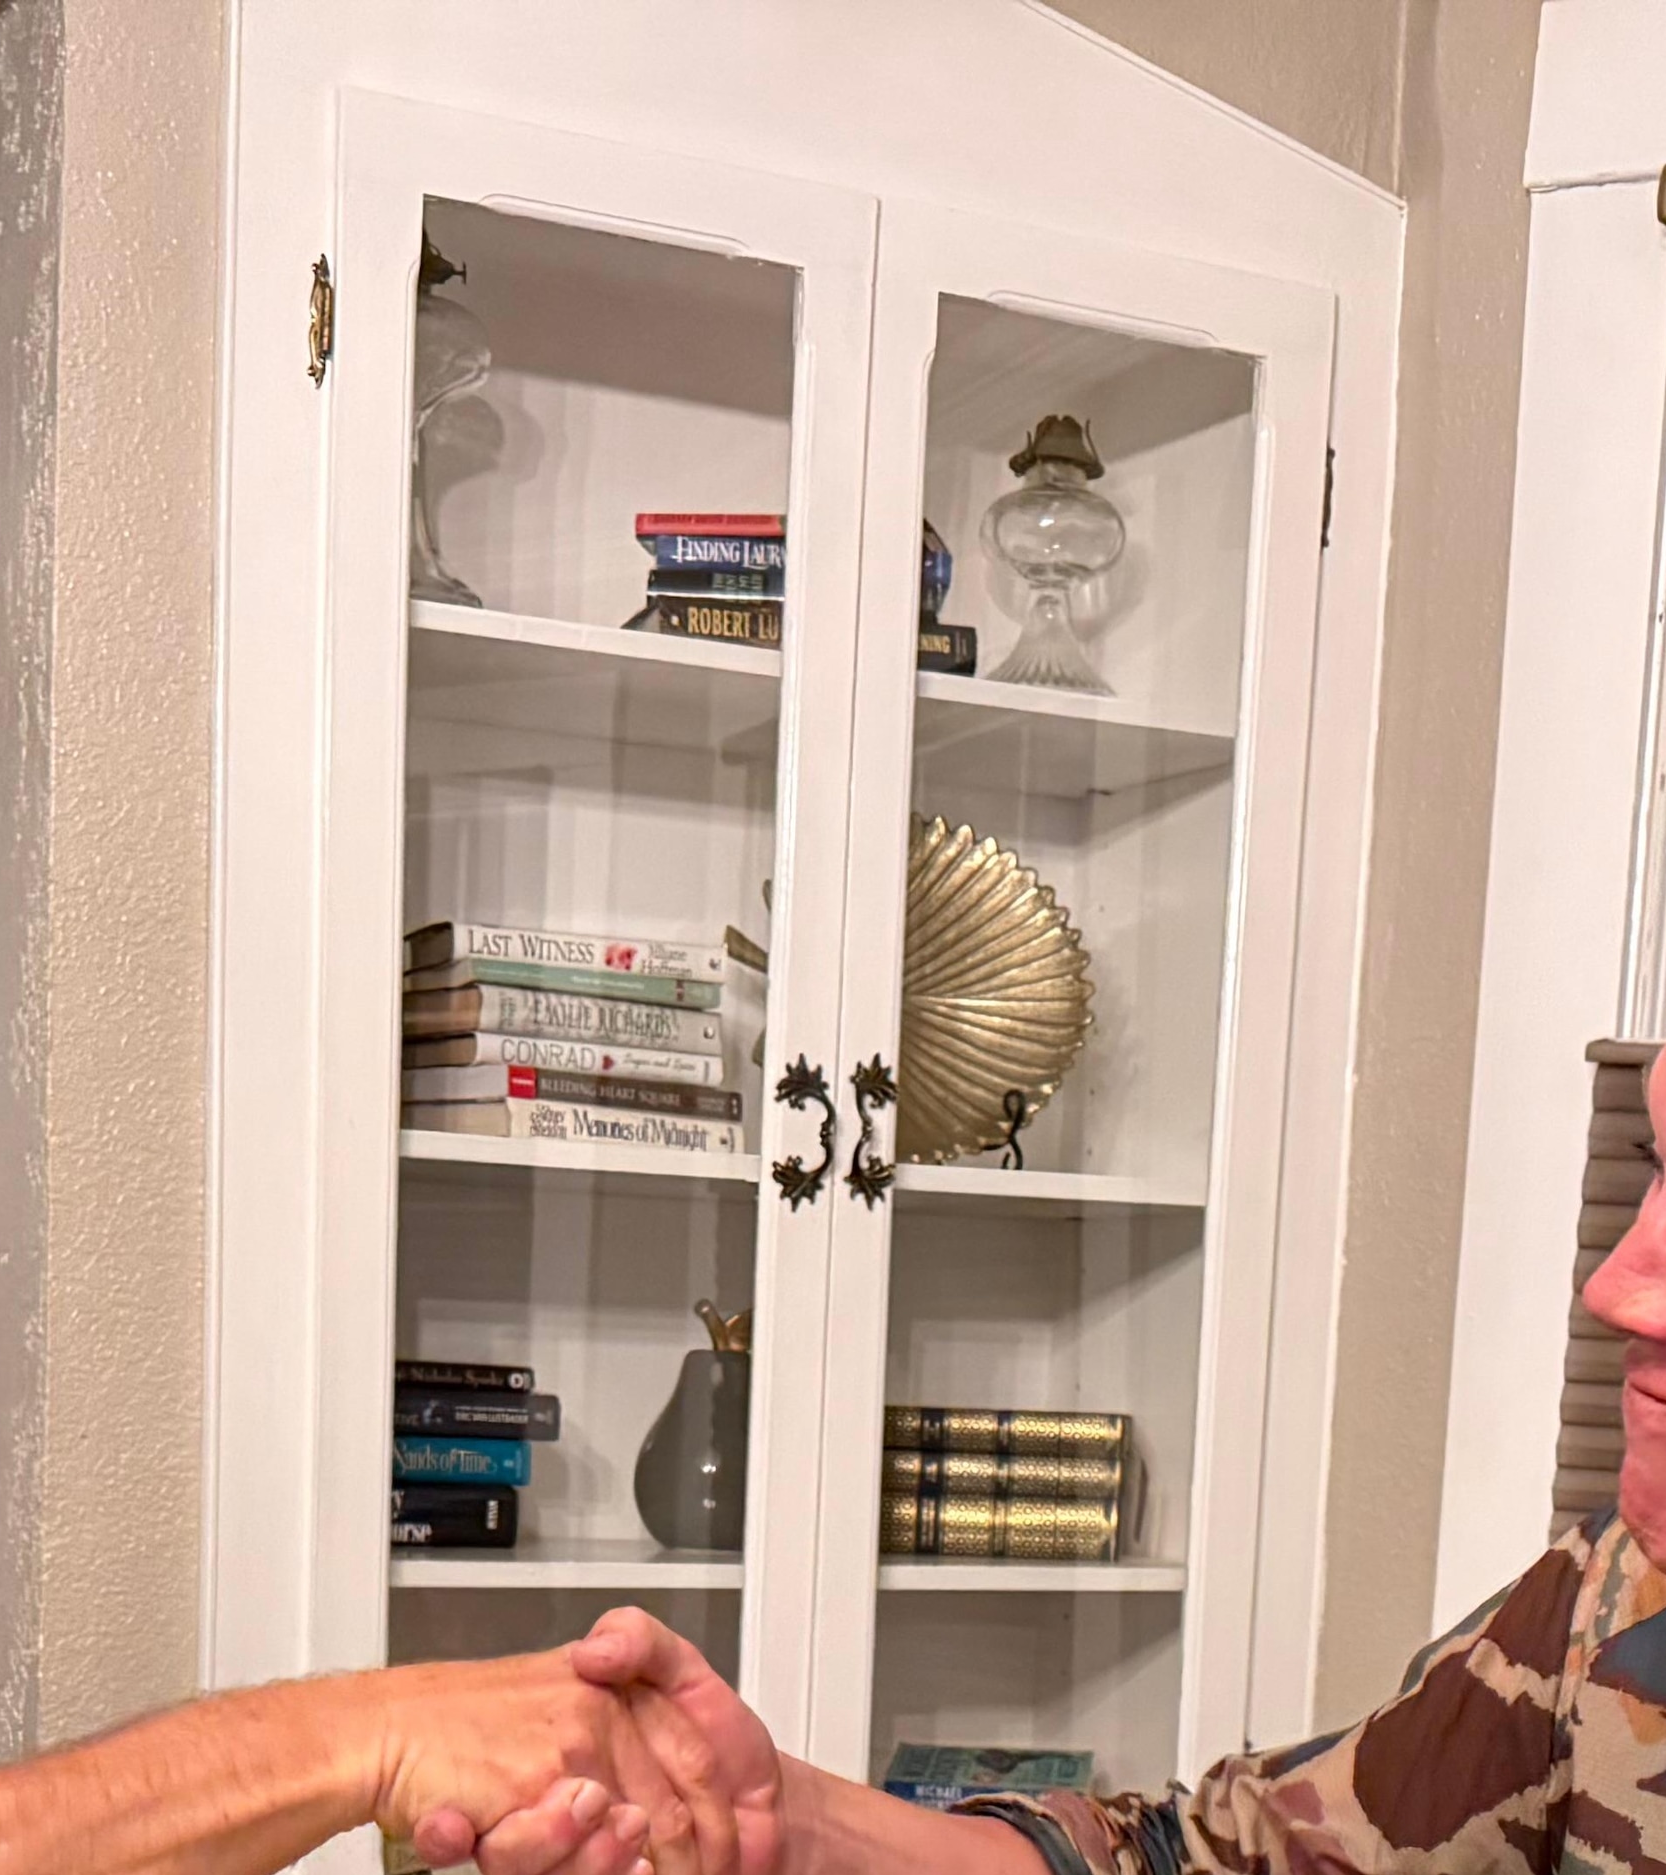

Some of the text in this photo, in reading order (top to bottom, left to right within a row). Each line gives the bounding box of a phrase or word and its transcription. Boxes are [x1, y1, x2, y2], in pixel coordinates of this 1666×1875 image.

[670, 535, 786, 569] FINDING LAUR
[687, 606, 751, 638] ROBERT
[467, 928, 595, 963] LAST WITNESS
[501, 1038, 596, 1072] CONRAD
[573, 1108, 634, 1142] Memories
[651, 1118, 710, 1152] Midnight
